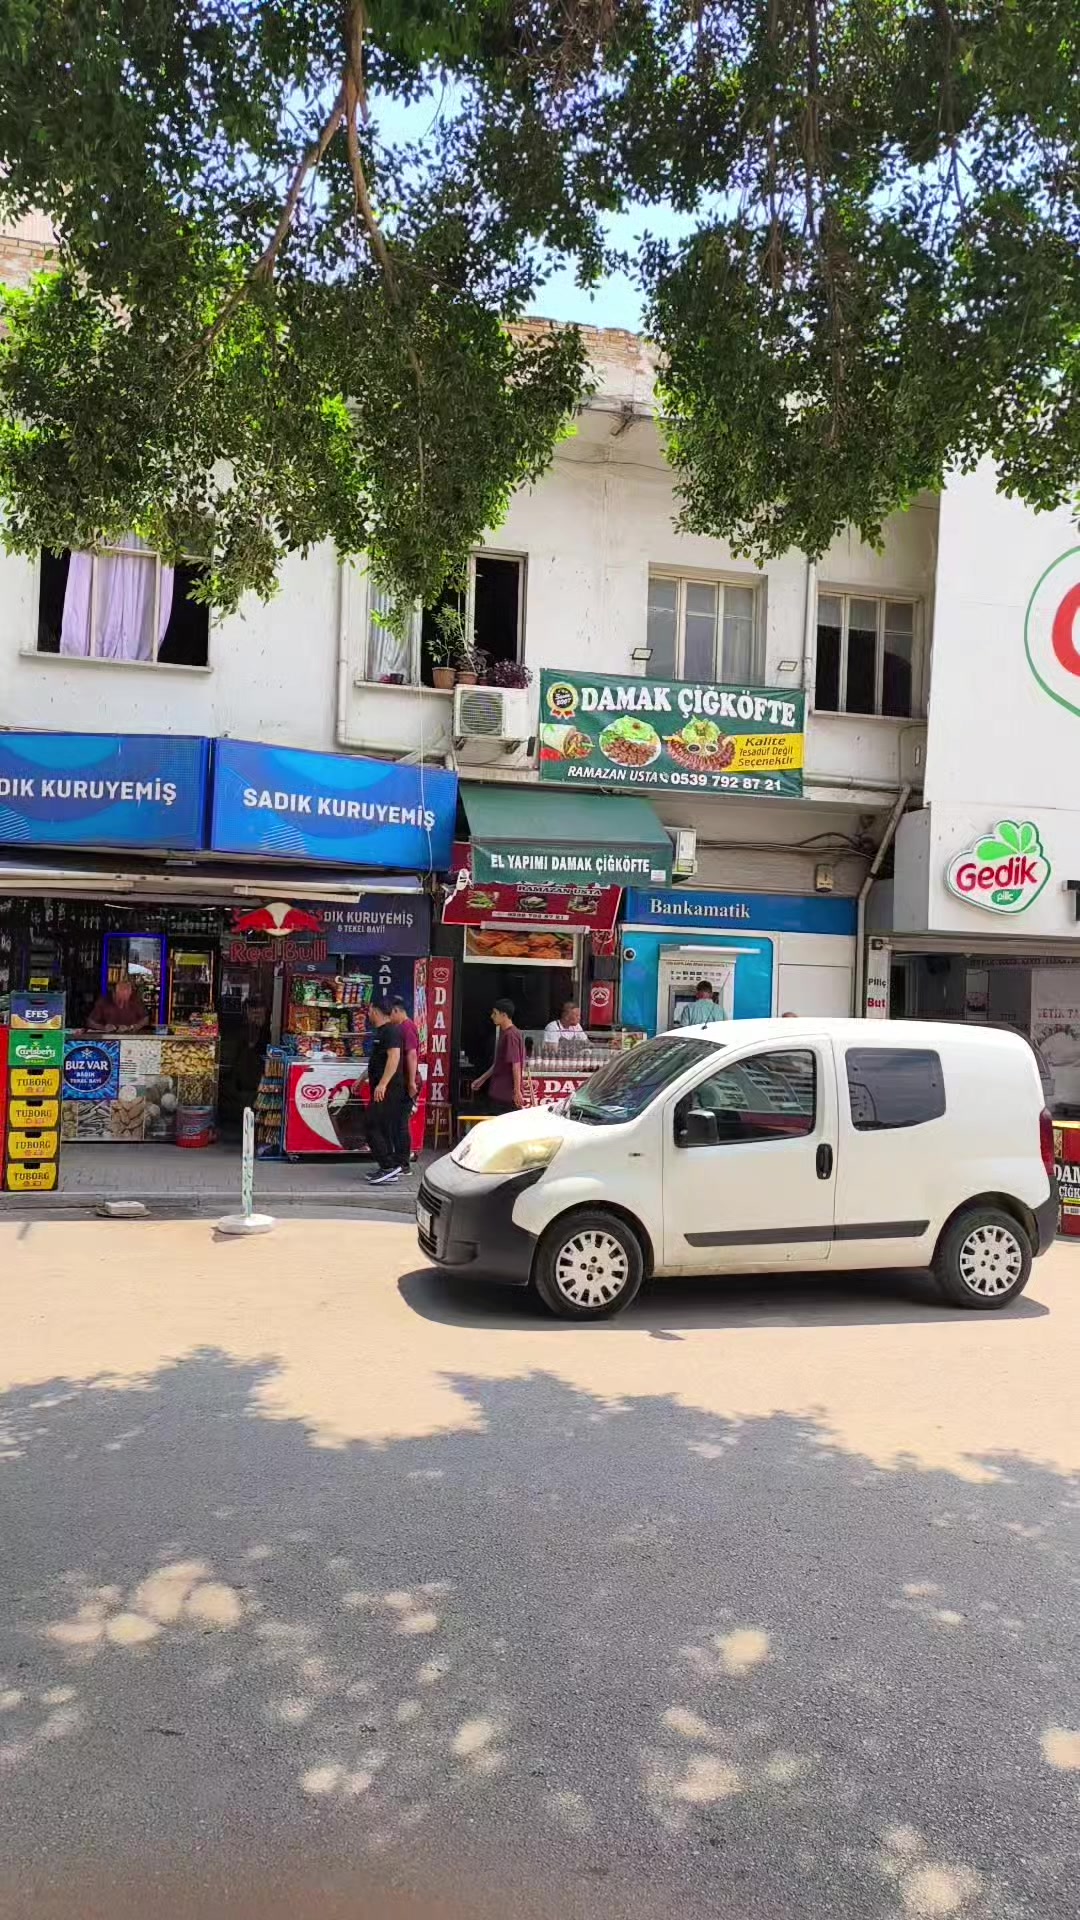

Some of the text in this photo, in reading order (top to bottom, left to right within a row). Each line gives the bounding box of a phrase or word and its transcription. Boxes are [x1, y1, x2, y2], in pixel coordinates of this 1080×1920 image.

[581, 687, 672, 711] DAMAK
[678, 687, 796, 728] ÇİĞKÖFTE
[745, 737, 786, 747] Kalite
[568, 766, 781, 790] RAMAZAN USTA 0539 792 87 21
[41, 777, 177, 805] KURUYEMİŞ
[243, 788, 436, 832] SADIK KURUYEMİŞ
[491, 854, 650, 874] EL YAPIMI DAMAK ÇİĞKÖFTE
[956, 856, 1038, 891] Gedik
[518, 886, 572, 894] RAMAZAN
[651, 899, 750, 918] Bankamatik
[346, 909, 414, 928] KURUYEMİŞ
[344, 925, 365, 933] TEKEL
[231, 940, 327, 962] Red Bull
[25, 1010, 49, 1018] EFES
[16, 1045, 56, 1059] Carlsberg
[66, 1060, 85, 1070] BUZ
[86, 1060, 109, 1070] VAR
[17, 1079, 53, 1087] TUBORG
[16, 1110, 52, 1118] TUBORG
[15, 1173, 50, 1181] TUBORG
